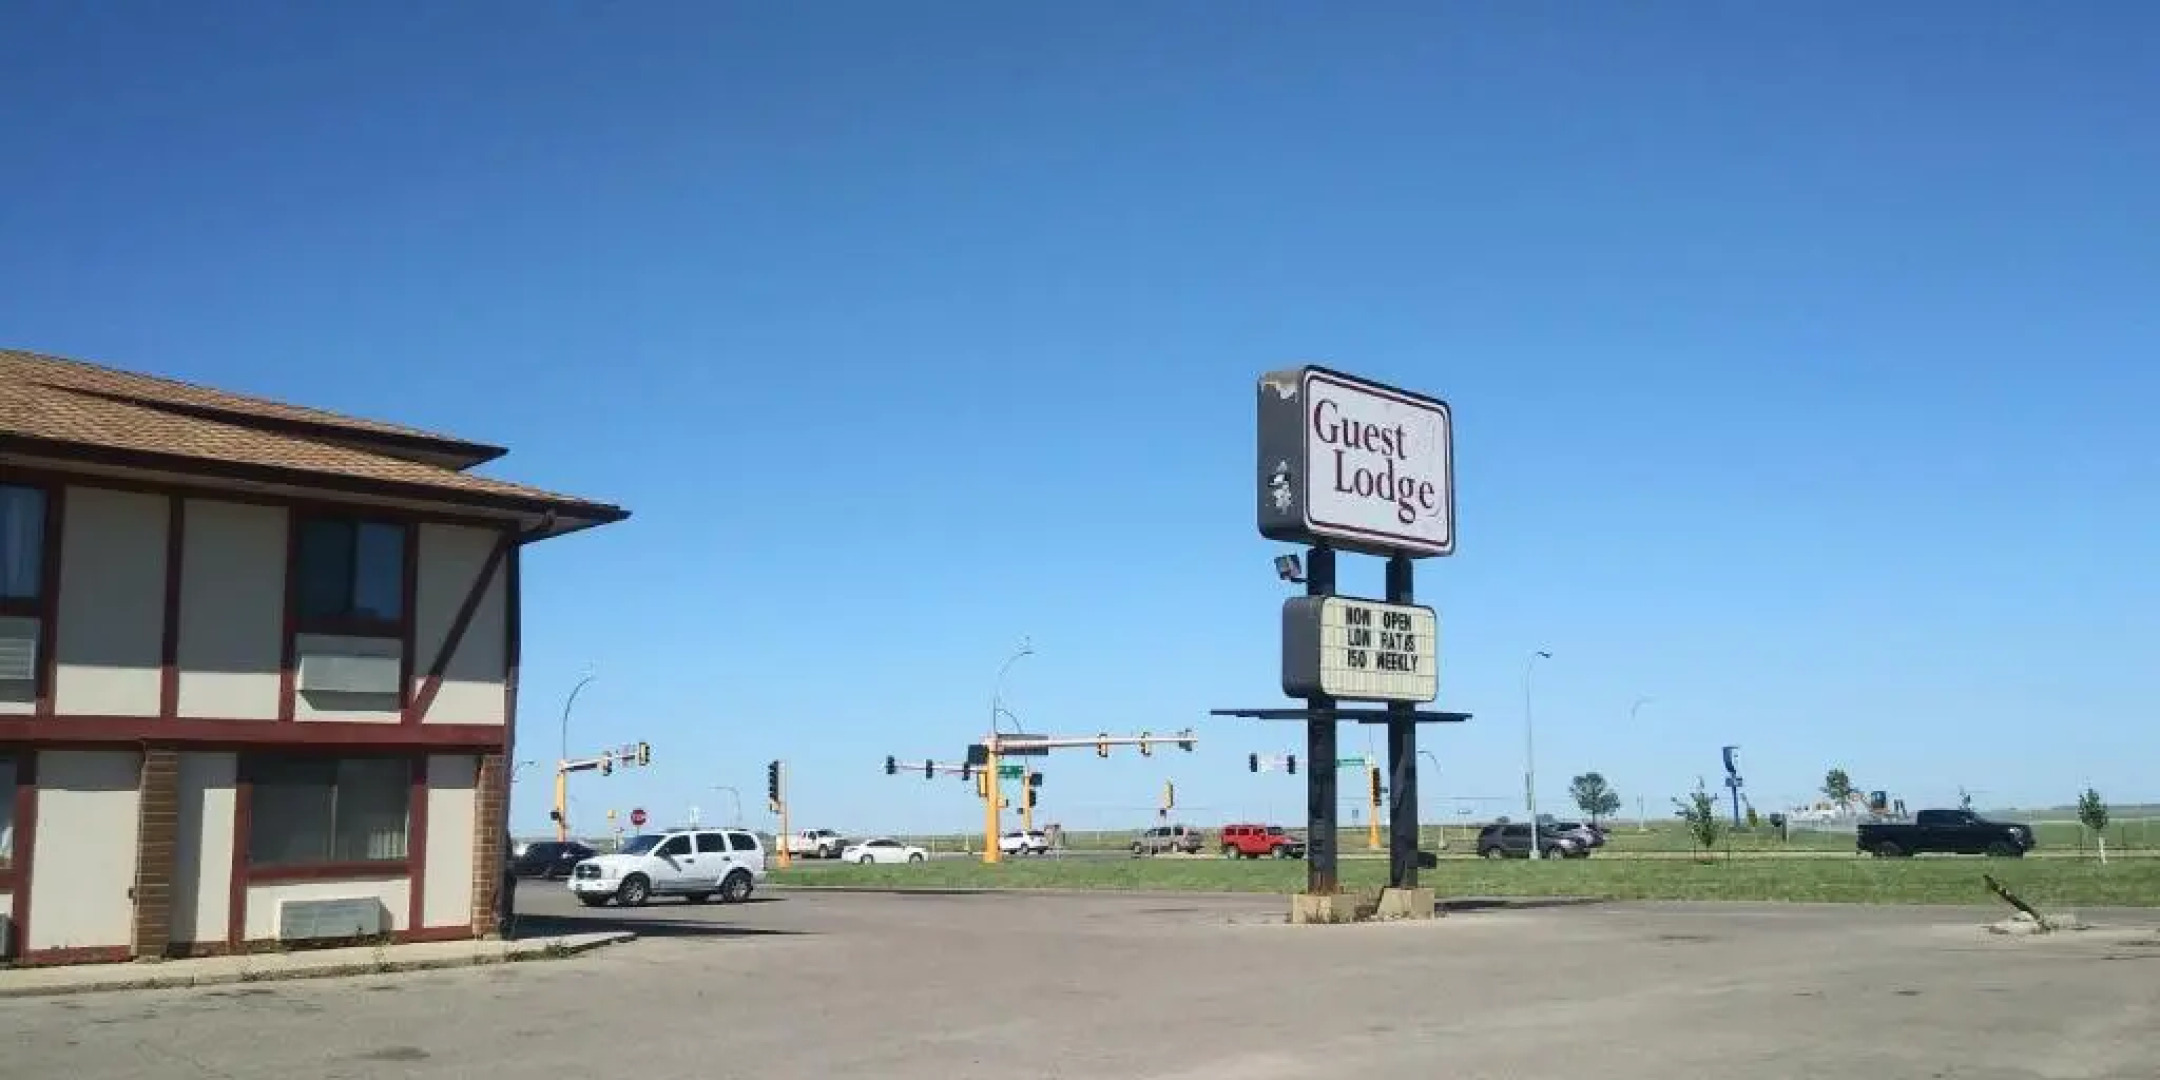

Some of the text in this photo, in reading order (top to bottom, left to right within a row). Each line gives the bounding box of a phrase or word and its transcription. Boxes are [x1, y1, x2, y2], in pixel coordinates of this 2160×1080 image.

[1313, 398, 1408, 460] Guest
[1334, 448, 1435, 523] Lodge
[1383, 611, 1412, 632] OPEN
[1347, 649, 1368, 669] 150
